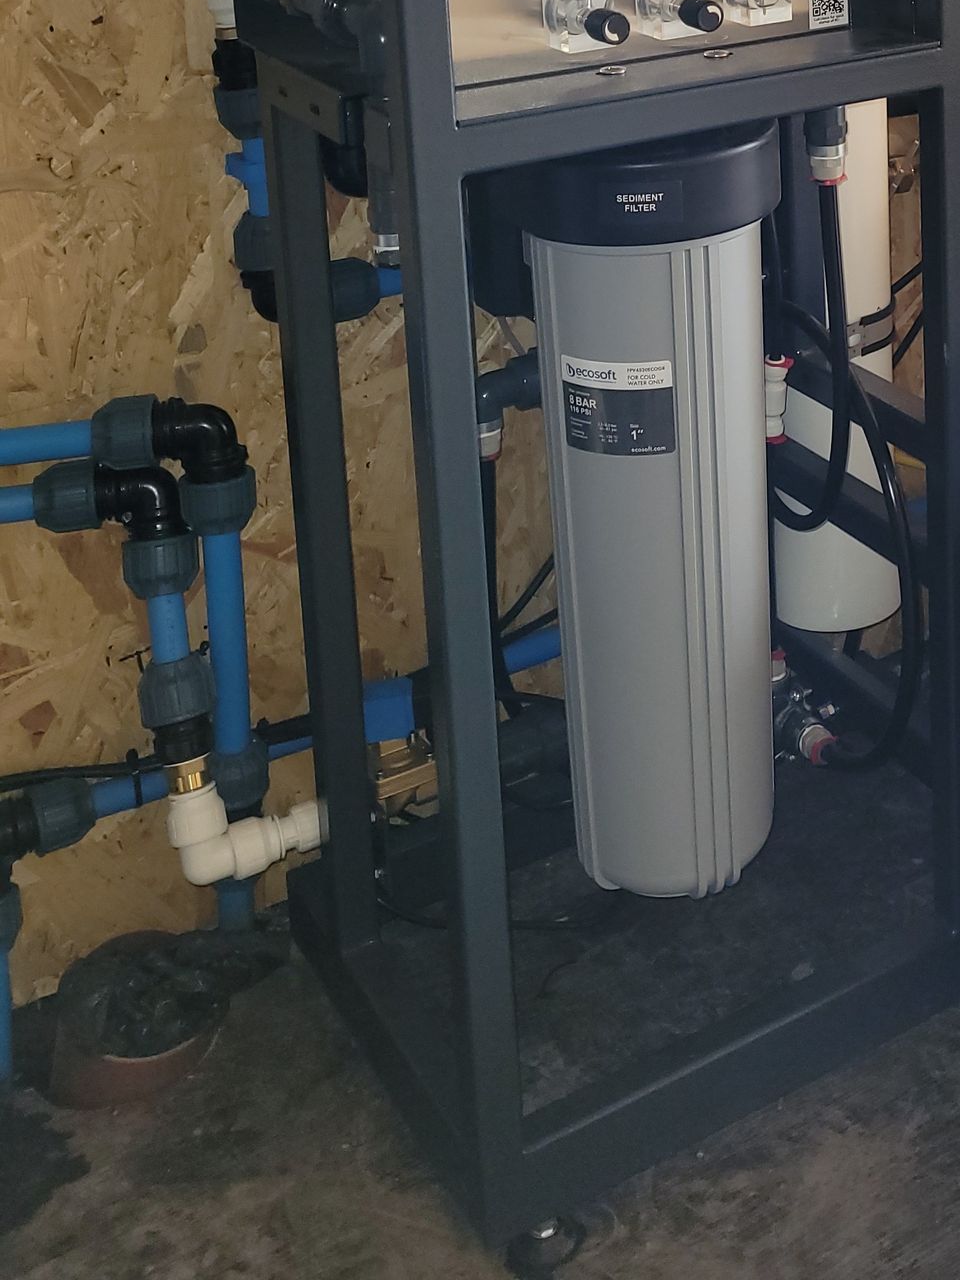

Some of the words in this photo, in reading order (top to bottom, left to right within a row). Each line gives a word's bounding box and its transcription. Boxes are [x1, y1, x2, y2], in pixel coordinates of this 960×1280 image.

[616, 192, 664, 203] SEDIMENT
[624, 203, 656, 213] FILTER
[576, 368, 617, 380] ecosoft
[569, 394, 575, 404] 8
[575, 396, 597, 409] BAR
[580, 408, 592, 416] PSI
[631, 445, 666, 453] ecosoft.com
